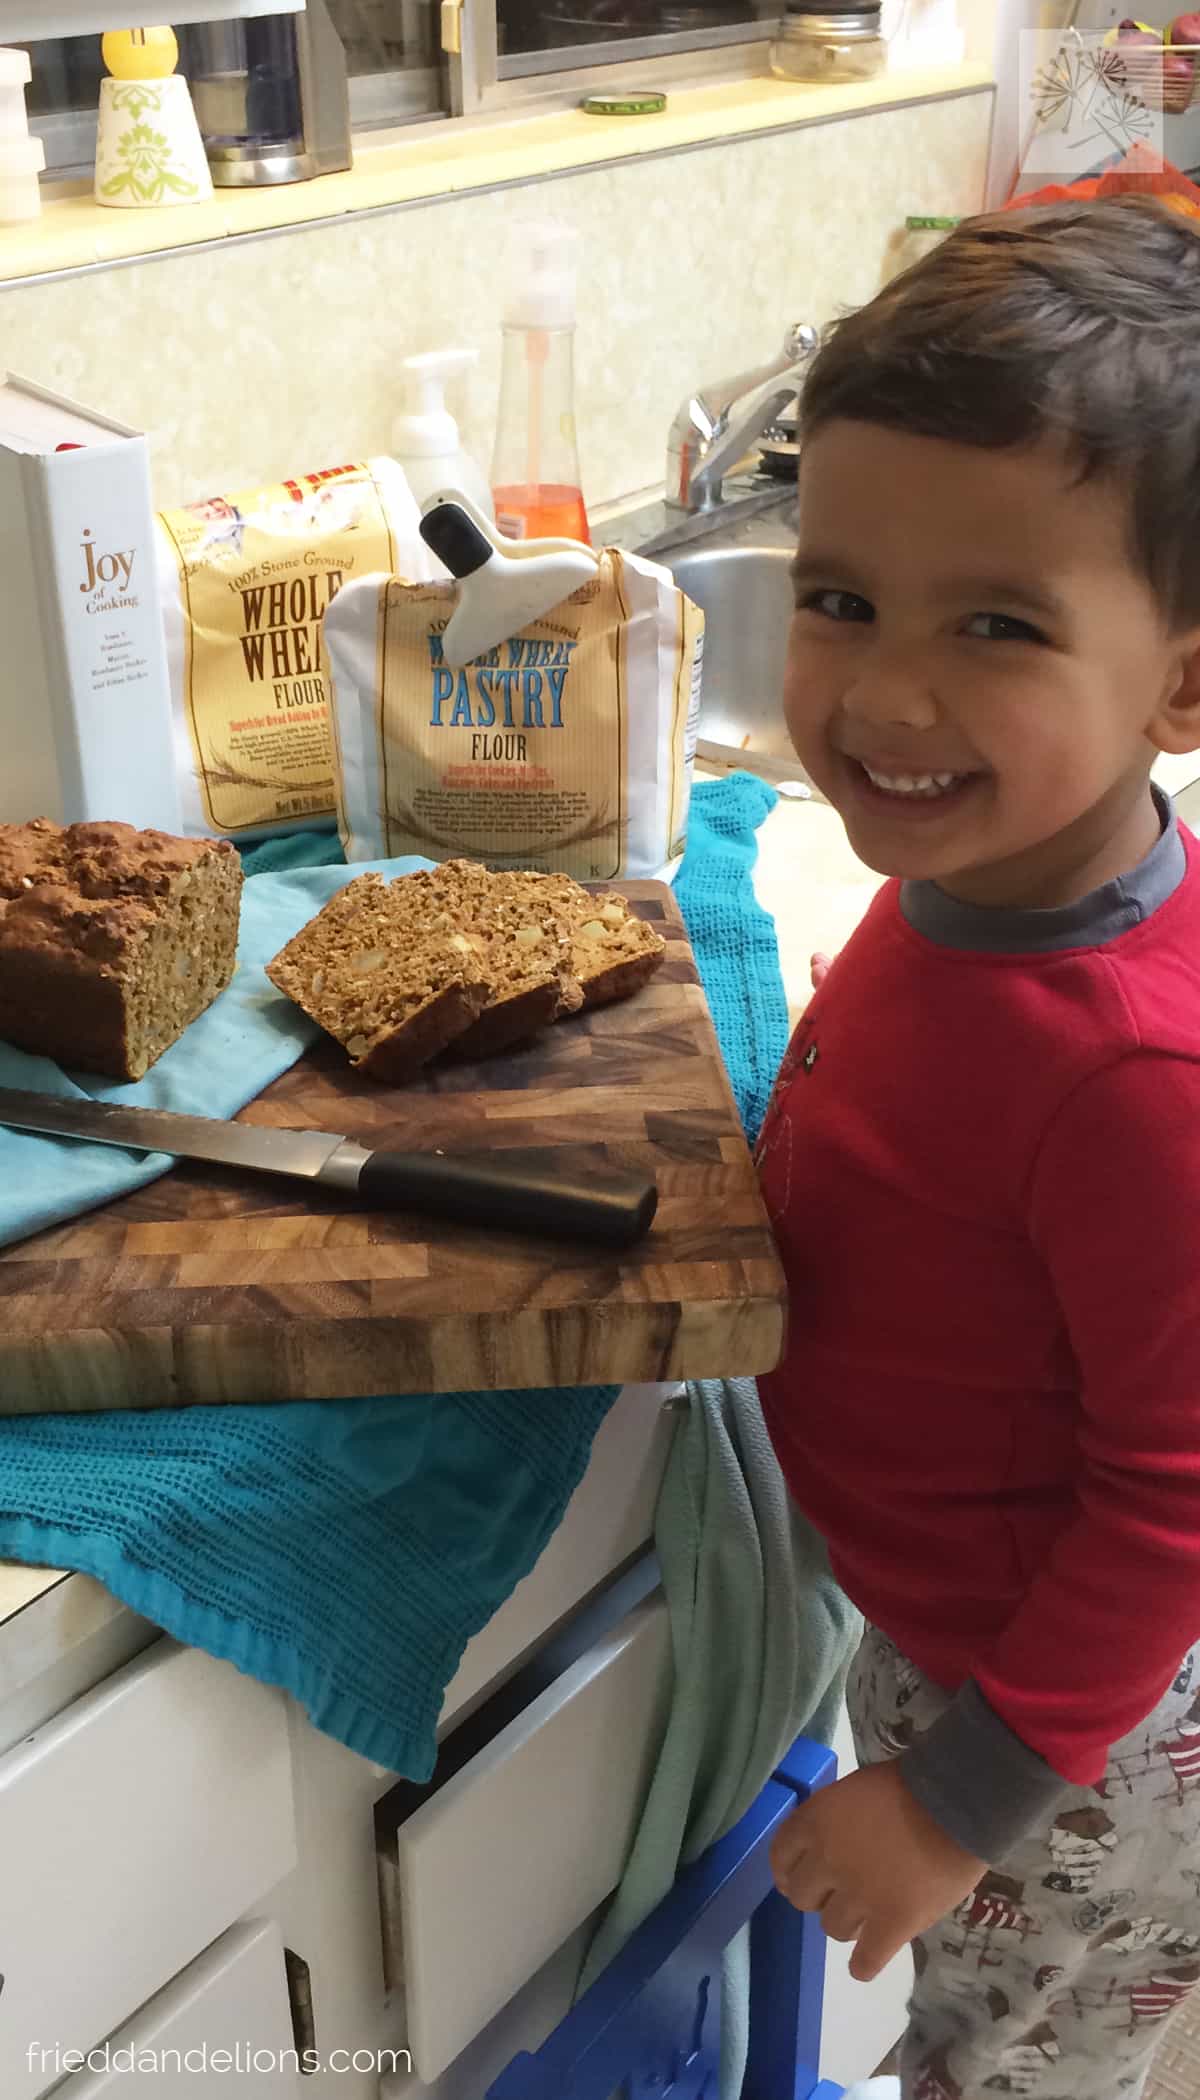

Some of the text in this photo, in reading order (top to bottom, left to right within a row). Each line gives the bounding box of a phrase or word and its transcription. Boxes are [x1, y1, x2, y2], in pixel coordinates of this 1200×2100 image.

[79, 528, 137, 593] joy
[261, 560, 300, 576] Stone
[303, 551, 355, 570] Ground
[86, 595, 140, 614] Cooking
[239, 623, 322, 683] WHE
[508, 636, 579, 668] WHEAT
[273, 678, 326, 709] FLOUR
[429, 667, 569, 728] PASTRY
[471, 733, 527, 761] FLOUR
